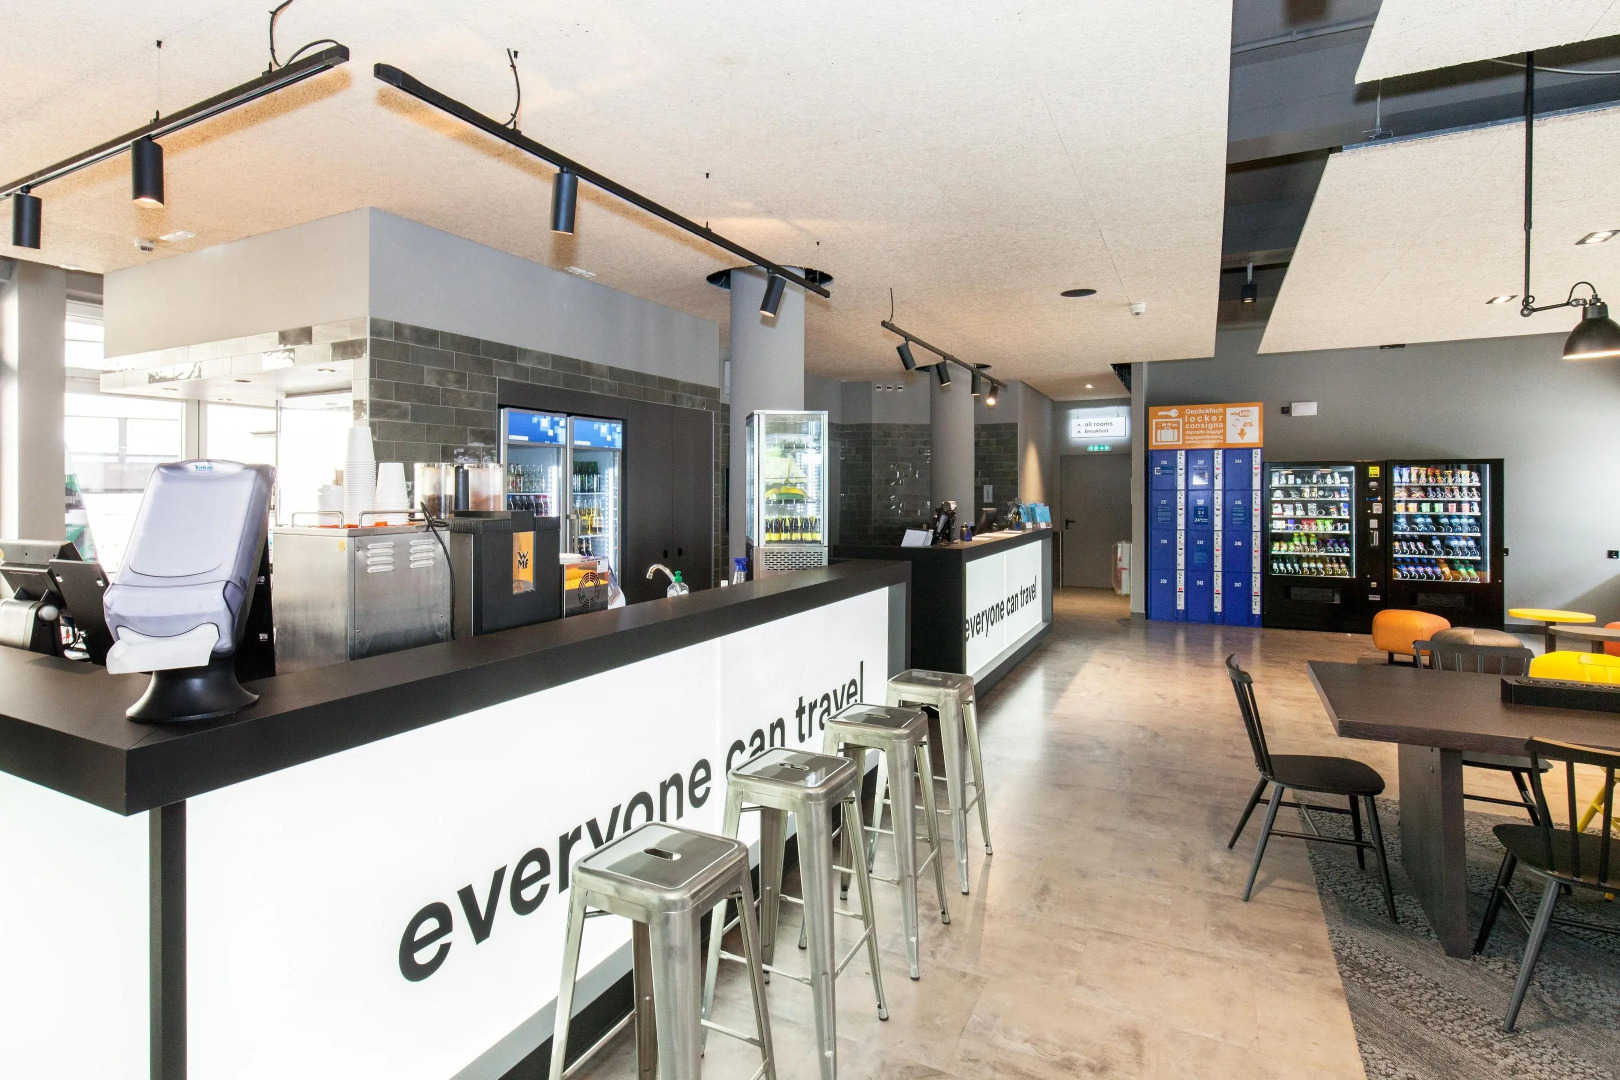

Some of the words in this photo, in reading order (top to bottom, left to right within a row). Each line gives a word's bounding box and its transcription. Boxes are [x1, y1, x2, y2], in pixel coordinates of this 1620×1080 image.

[1185, 414, 1224, 423] locker
[1185, 422, 1224, 430] consigna
[965, 600, 1005, 642] everyone
[1006, 594, 1019, 617] can
[1019, 575, 1037, 608] travel
[795, 660, 864, 744] travel
